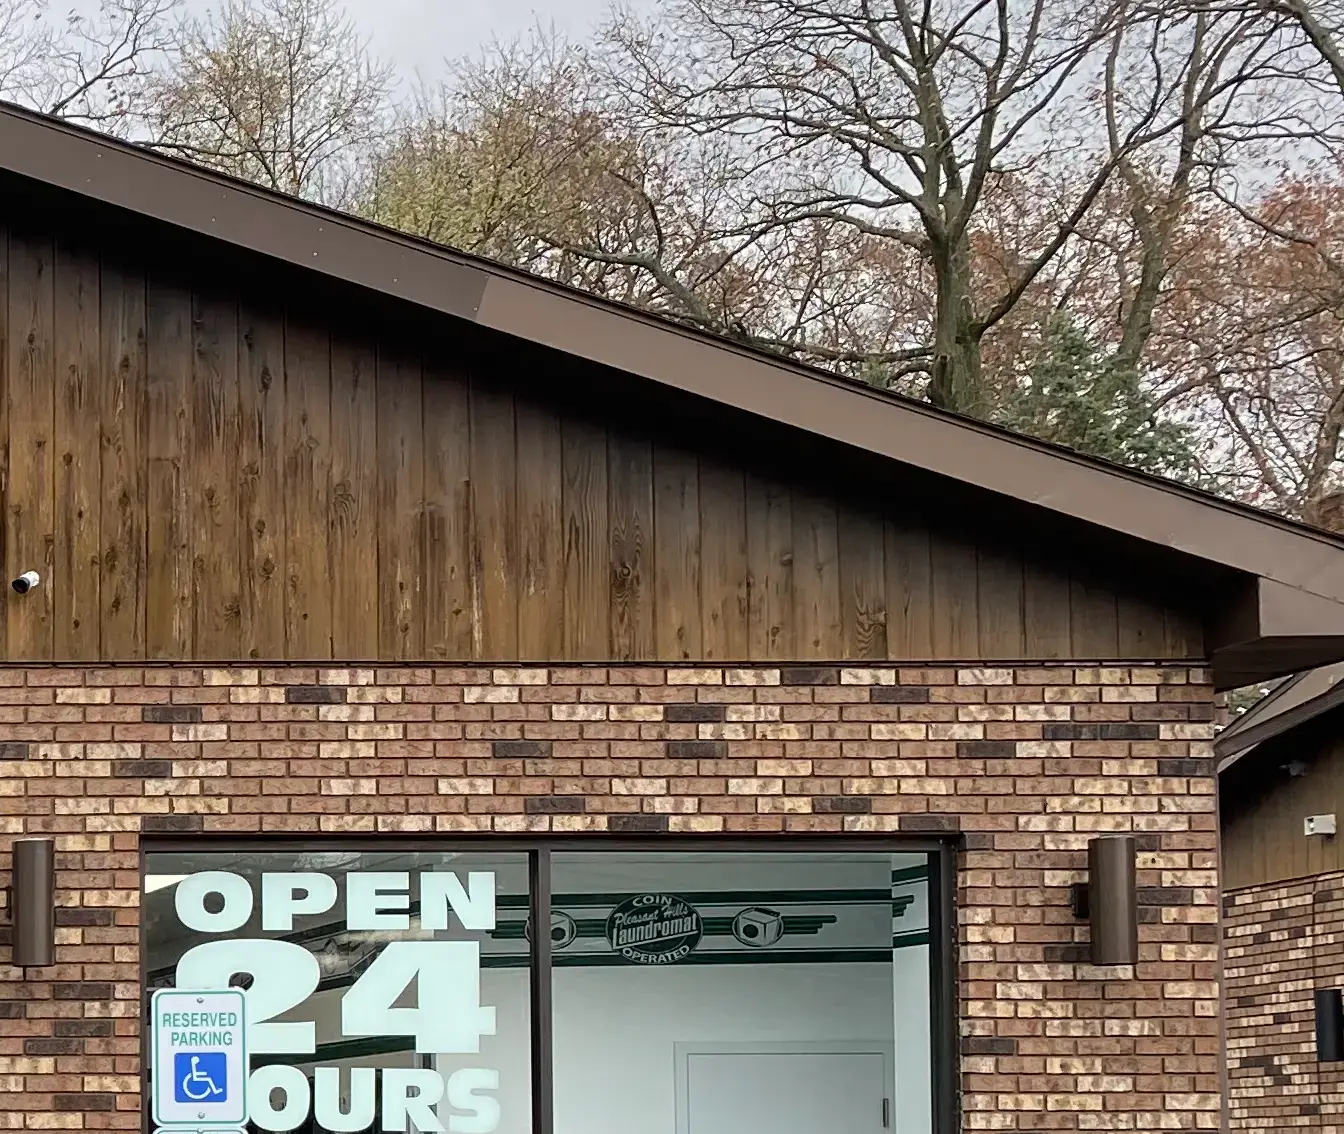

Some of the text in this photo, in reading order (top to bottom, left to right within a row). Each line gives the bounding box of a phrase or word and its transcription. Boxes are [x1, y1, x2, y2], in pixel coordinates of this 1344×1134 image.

[174, 870, 496, 932] OPEN
[632, 895, 673, 906] COIN
[614, 903, 688, 928] Pleasant Hills
[613, 913, 698, 950] Laundromat
[622, 945, 690, 964] OPERATED
[176, 939, 497, 1054] 24
[162, 1012, 237, 1027] RESERVED
[171, 1031, 233, 1046] PARKING
[249, 1065, 500, 1132] OURS
